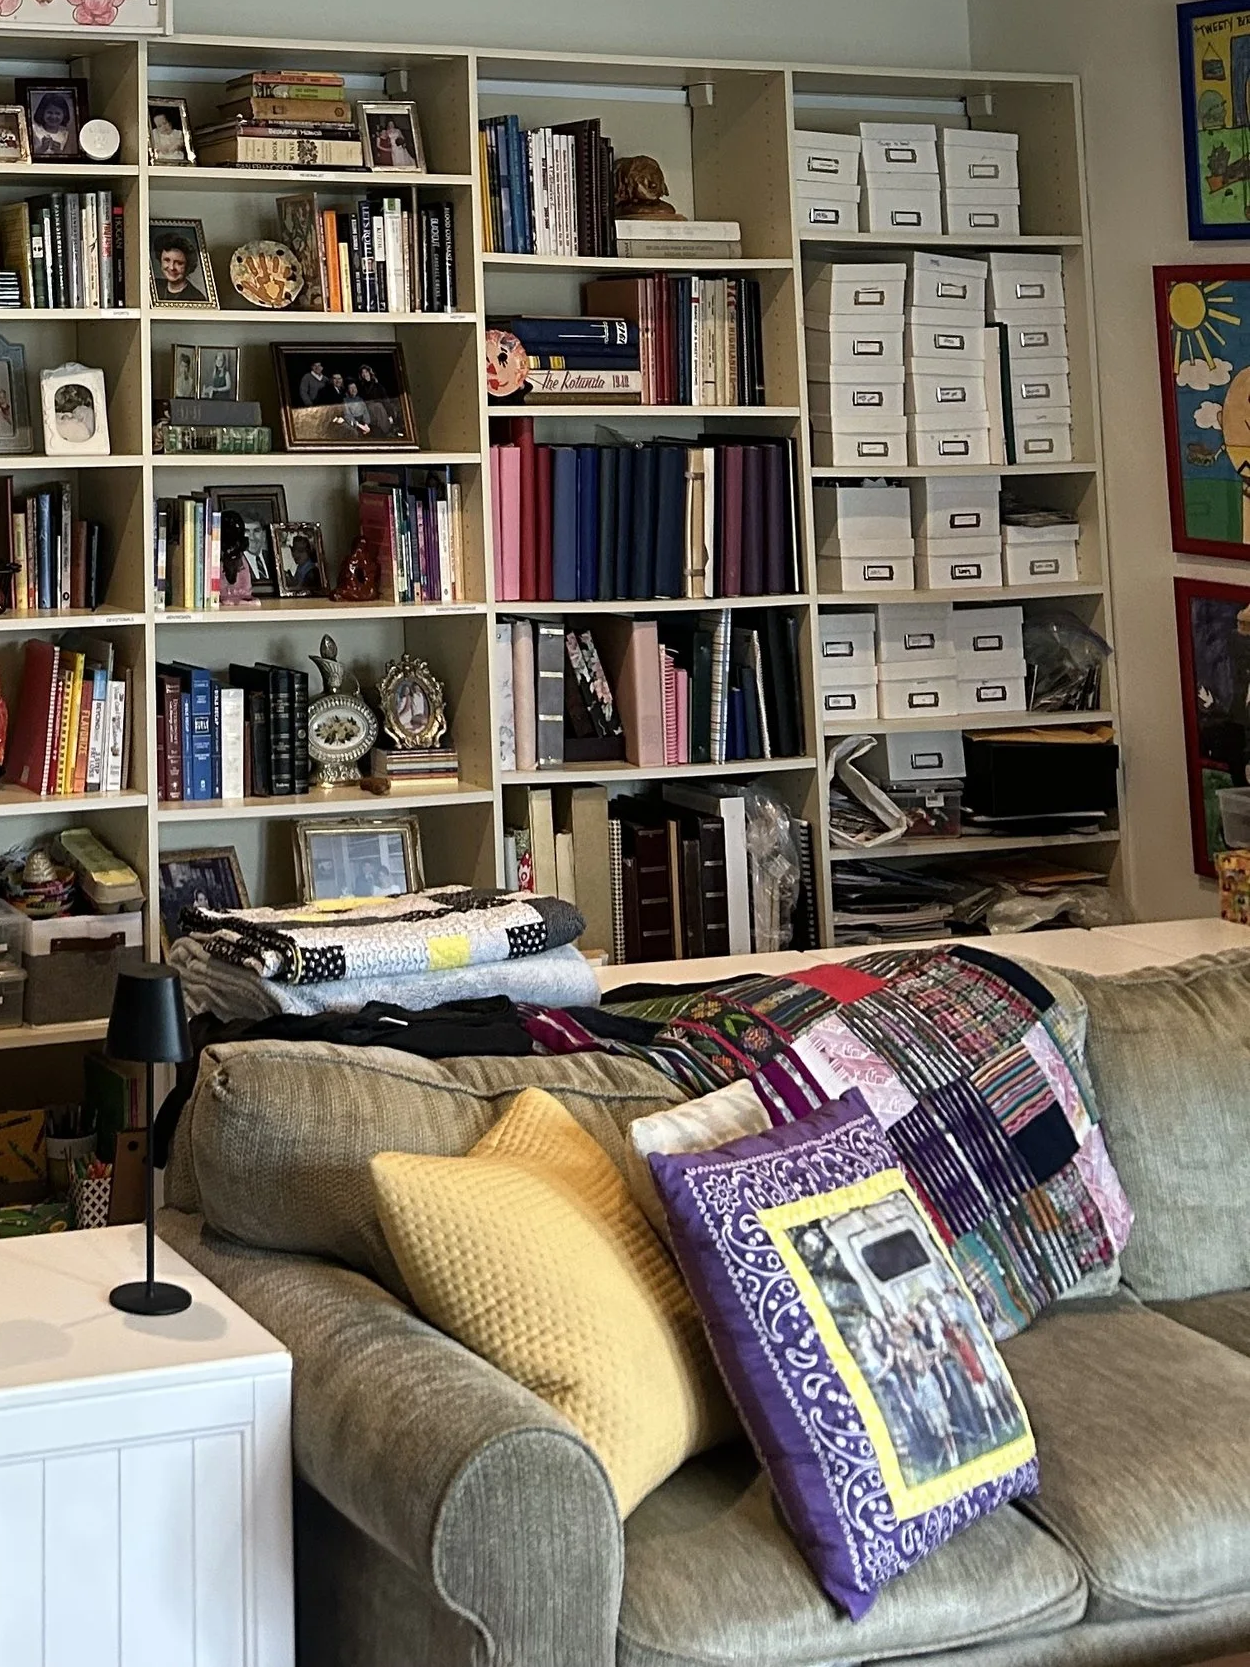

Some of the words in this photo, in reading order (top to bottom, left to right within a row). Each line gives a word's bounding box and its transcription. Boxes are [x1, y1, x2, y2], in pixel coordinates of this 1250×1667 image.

[114, 216, 123, 249] HOGAN
[430, 218, 440, 248] BLACKOUT
[541, 369, 558, 390] The
[560, 370, 605, 390] Rotunda
[94, 702, 102, 730] BEYOND
[79, 709, 90, 755] FLAVORIZE
